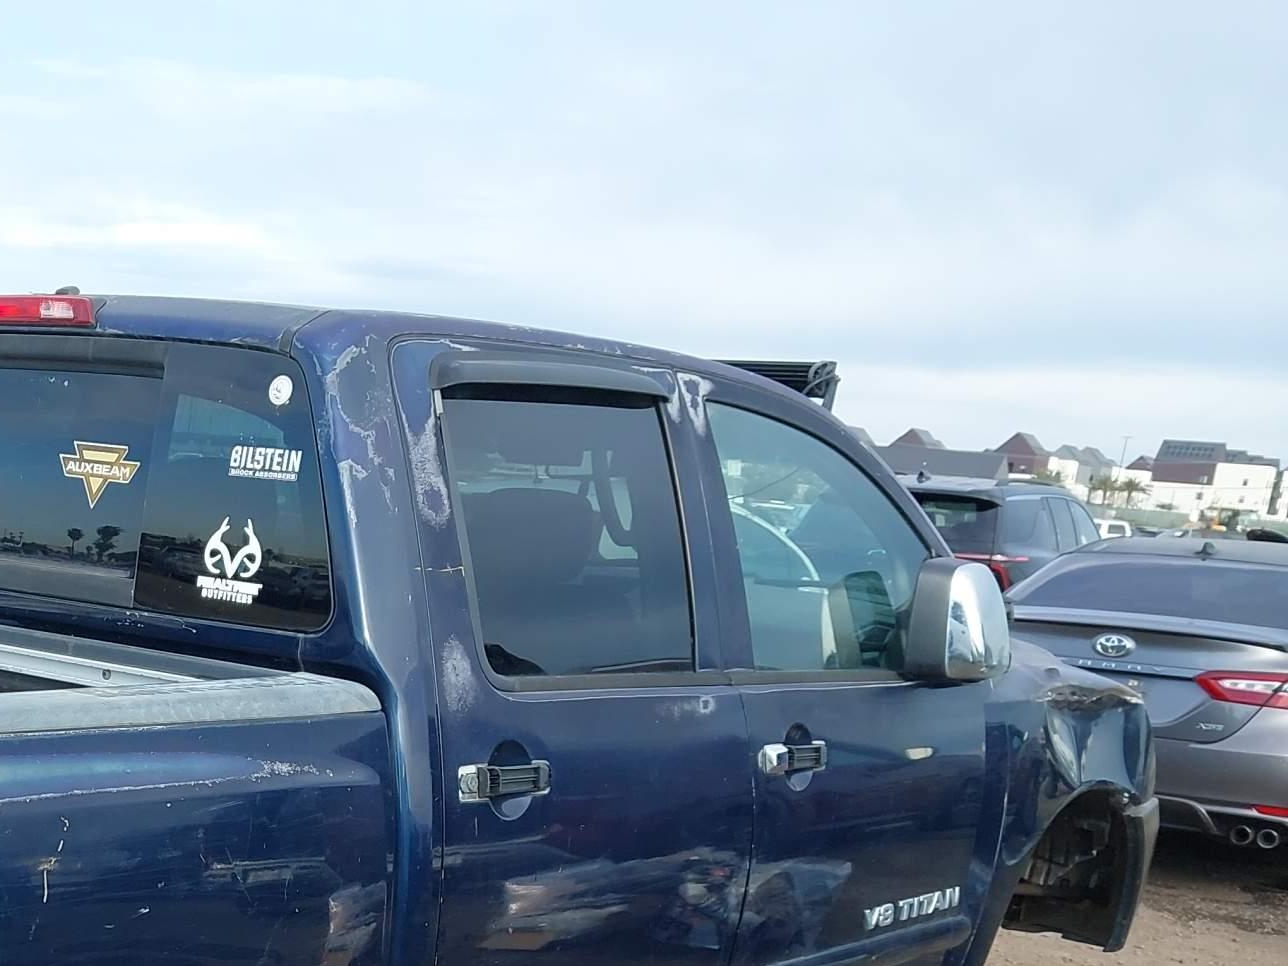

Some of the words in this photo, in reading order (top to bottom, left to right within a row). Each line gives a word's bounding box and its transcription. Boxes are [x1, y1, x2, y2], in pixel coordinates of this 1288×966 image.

[230, 445, 303, 473] BILSTEIN
[66, 460, 130, 480] AUXBEAM
[197, 576, 263, 595] ALTR
[201, 588, 253, 604] OUTFITTERS
[864, 903, 895, 930] V8
[898, 886, 961, 920] TITAN
